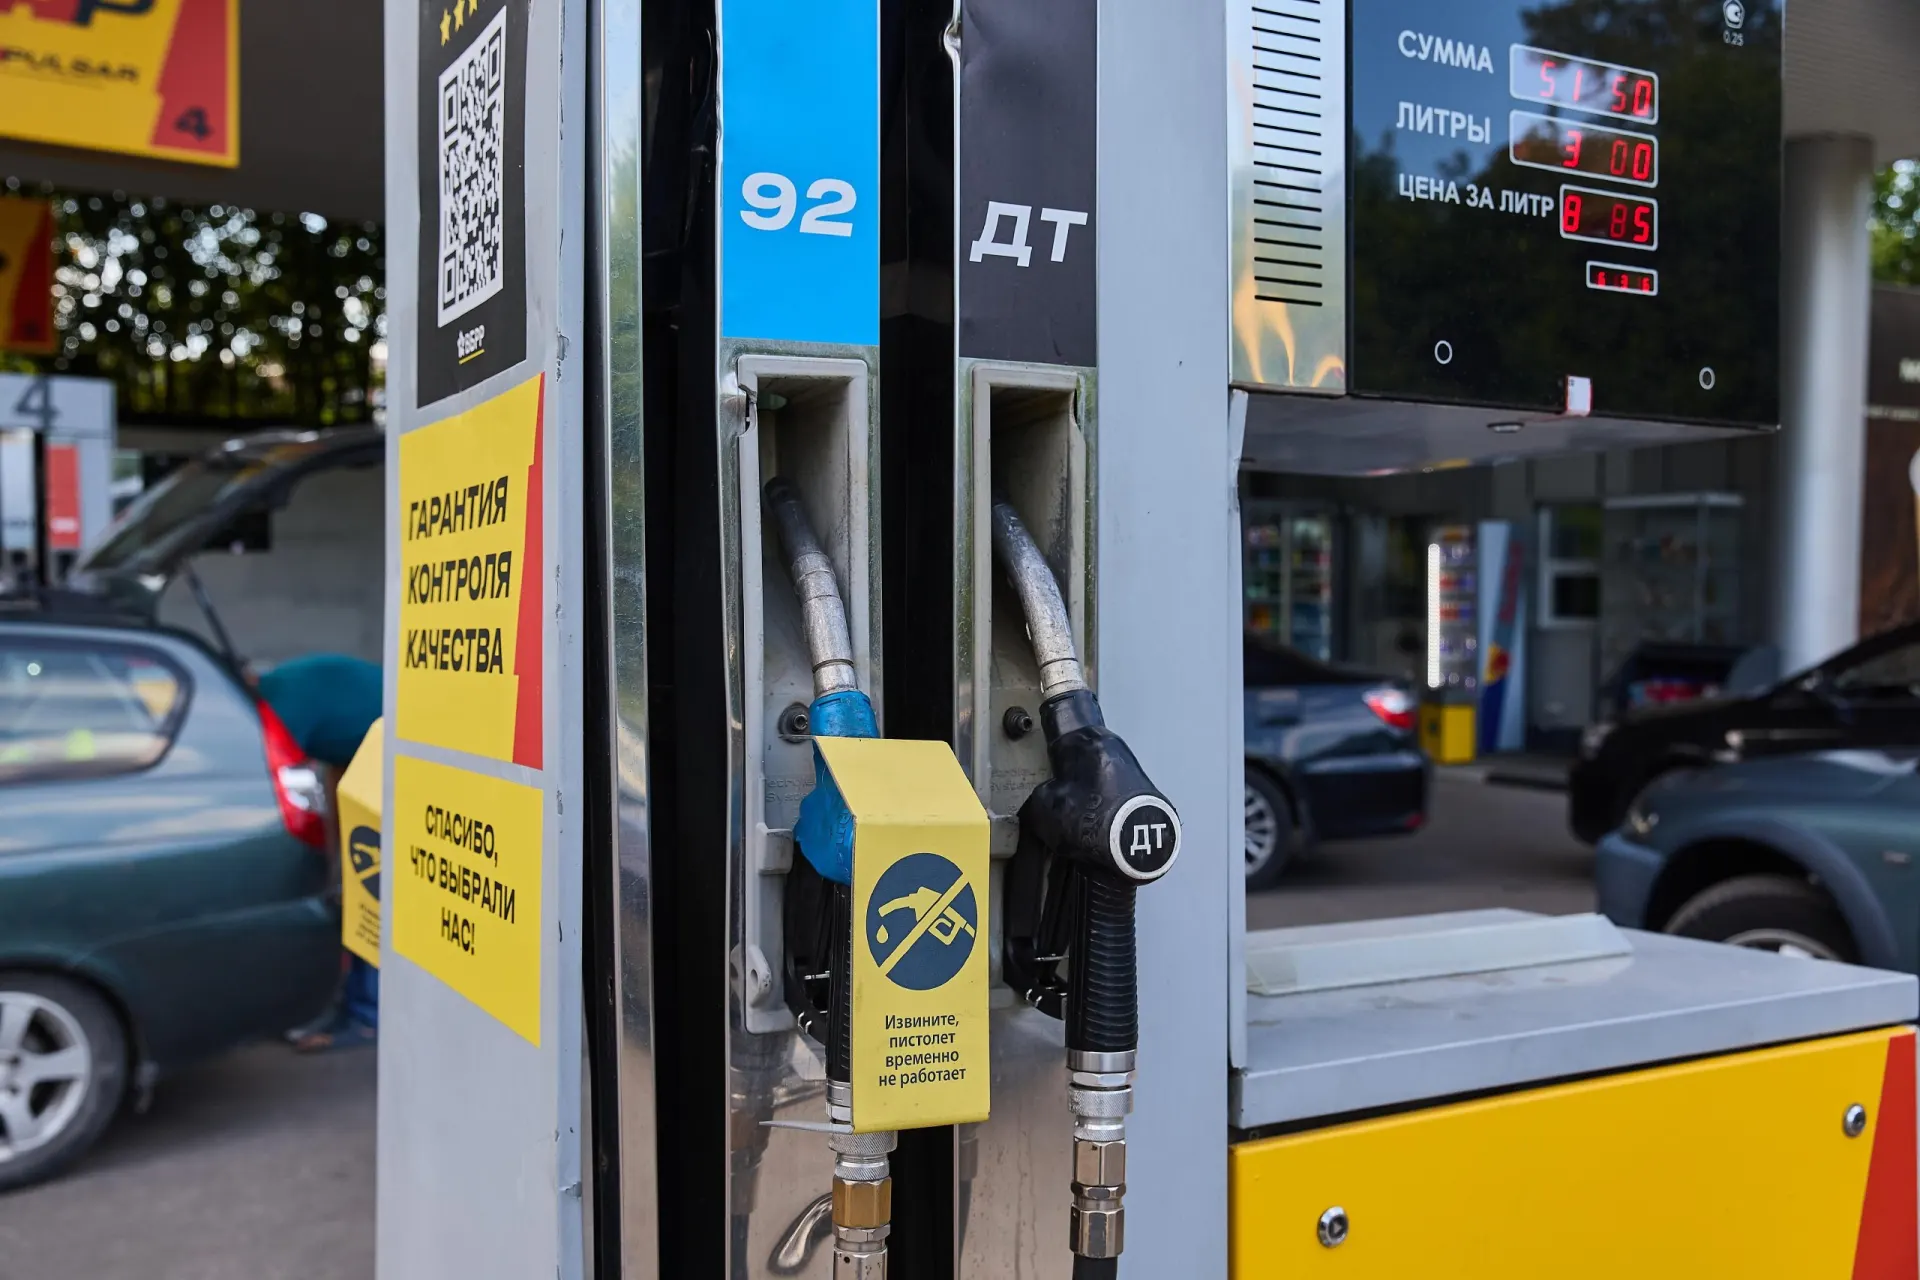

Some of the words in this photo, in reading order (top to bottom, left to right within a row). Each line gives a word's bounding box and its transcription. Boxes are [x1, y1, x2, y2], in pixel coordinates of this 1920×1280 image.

[1397, 30, 1495, 74] СУММА
[1396, 101, 1490, 144] ЛИТРЫ
[740, 172, 857, 237] 92
[1399, 173, 1461, 204] ЦЕНА
[1465, 184, 1495, 210] ЗА
[1499, 190, 1555, 218] ЛИТР
[969, 201, 1088, 267] ДТ
[15, 373, 61, 431] 4
[408, 475, 509, 541] ГАРАНТИЯ
[407, 550, 512, 604] КОНТРОЛЯ
[405, 627, 503, 674] КАЧЕСТВА
[425, 804, 498, 868] СПАСИБО,
[1130, 823, 1166, 856] ДТ
[410, 844, 436, 884] ЧТО
[439, 857, 515, 924] ВЫБРАЛИ
[441, 906, 475, 956] НАС!
[885, 1014, 959, 1030] Извините,
[889, 1032, 956, 1048] пистолет
[879, 1074, 896, 1087] не
[900, 1067, 966, 1089] работает
[885, 1050, 959, 1070] временно
